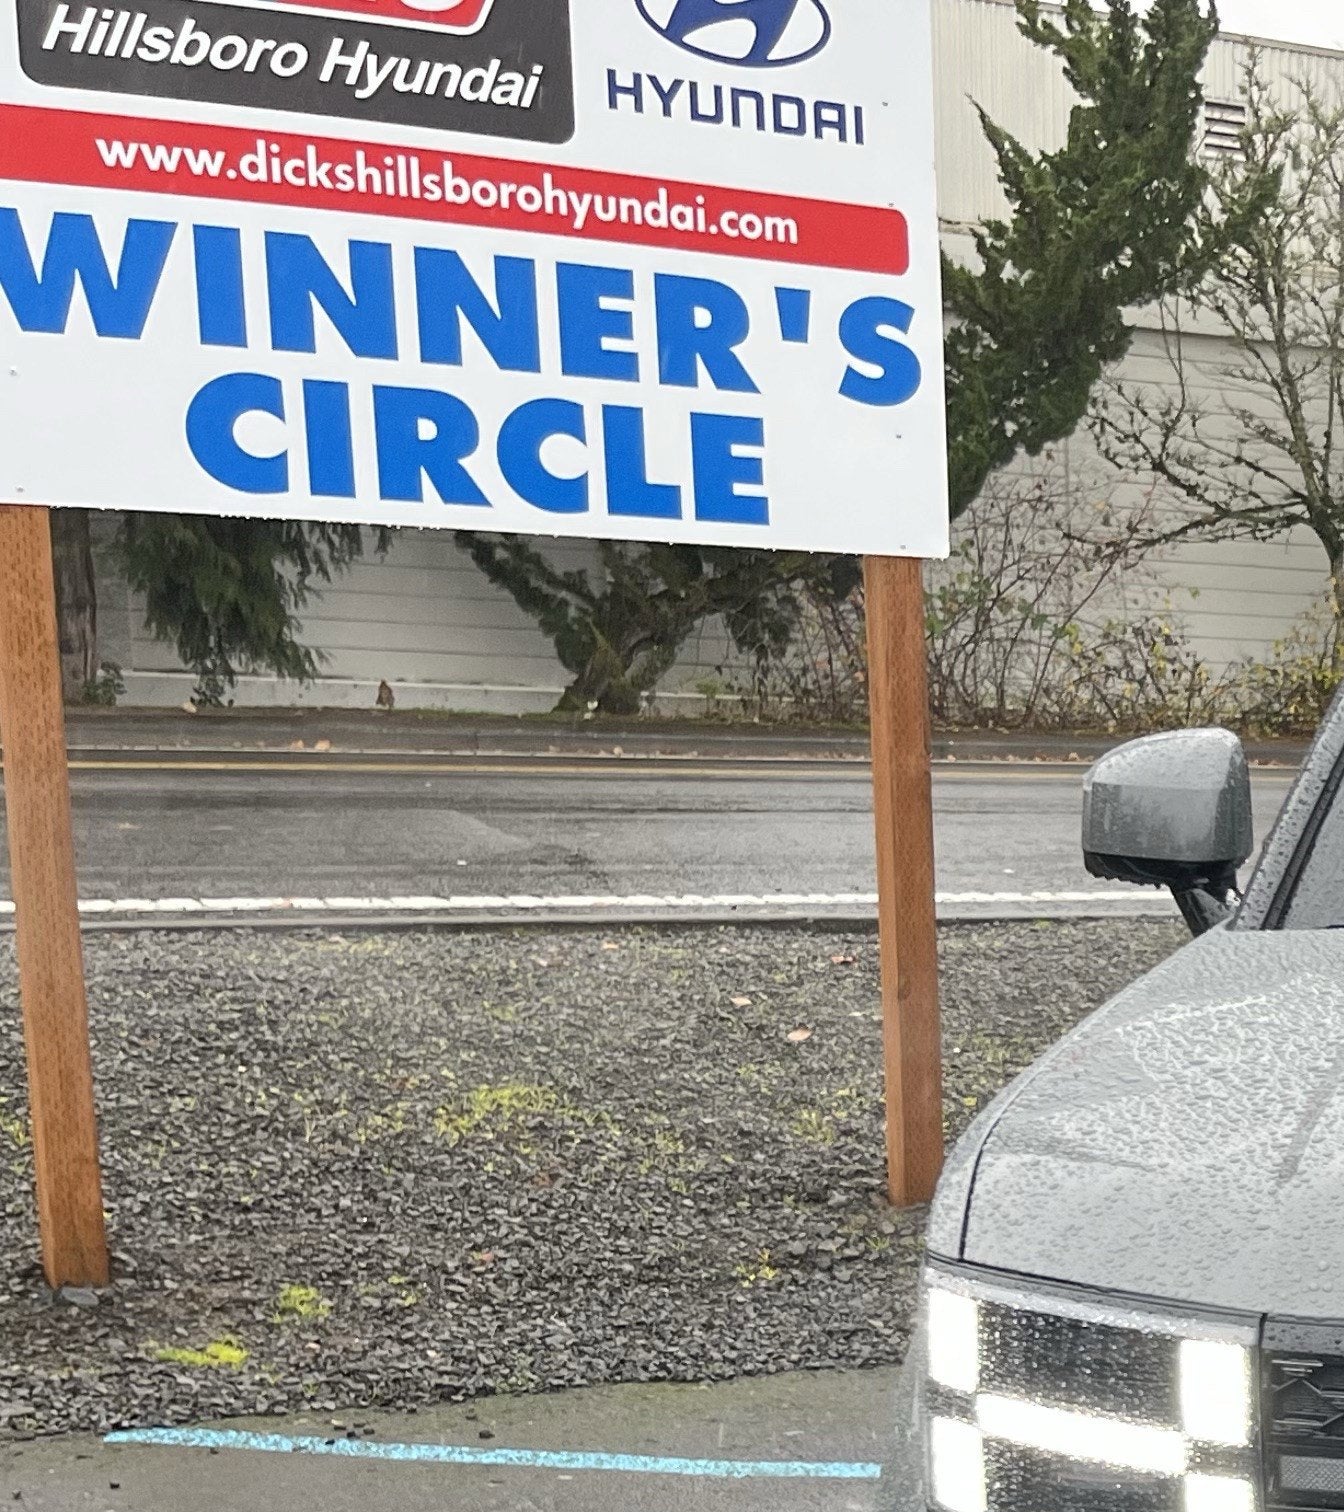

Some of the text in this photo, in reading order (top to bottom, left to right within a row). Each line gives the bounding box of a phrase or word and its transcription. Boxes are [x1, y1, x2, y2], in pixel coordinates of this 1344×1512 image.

[43, 4, 543, 108] Hillsboro Hyundai
[606, 68, 864, 145] HYUNDAI
[96, 136, 798, 245] www.dickshillsborohyundai.com
[0, 207, 922, 407] WINNER'S
[185, 372, 770, 526] CIRCLE
